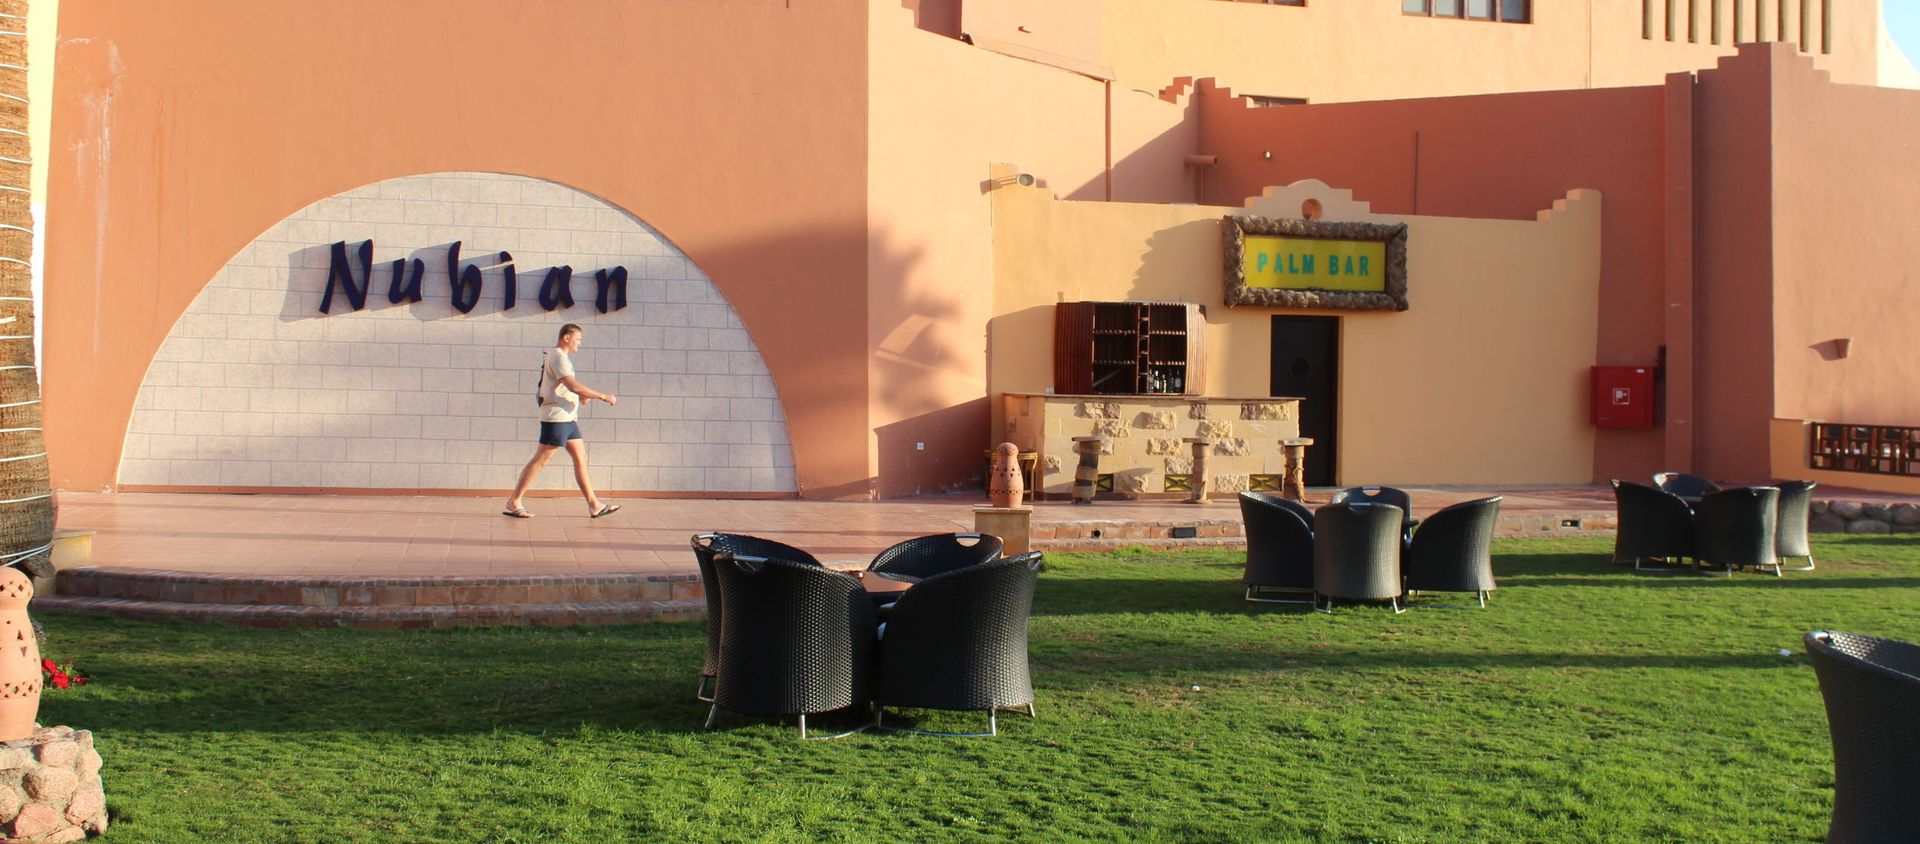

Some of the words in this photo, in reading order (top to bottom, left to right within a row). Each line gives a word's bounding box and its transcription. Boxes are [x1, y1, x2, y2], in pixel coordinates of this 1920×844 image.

[318, 238, 628, 314] Nubian
[1257, 252, 1315, 275] PALM
[1328, 254, 1370, 276] BAR
